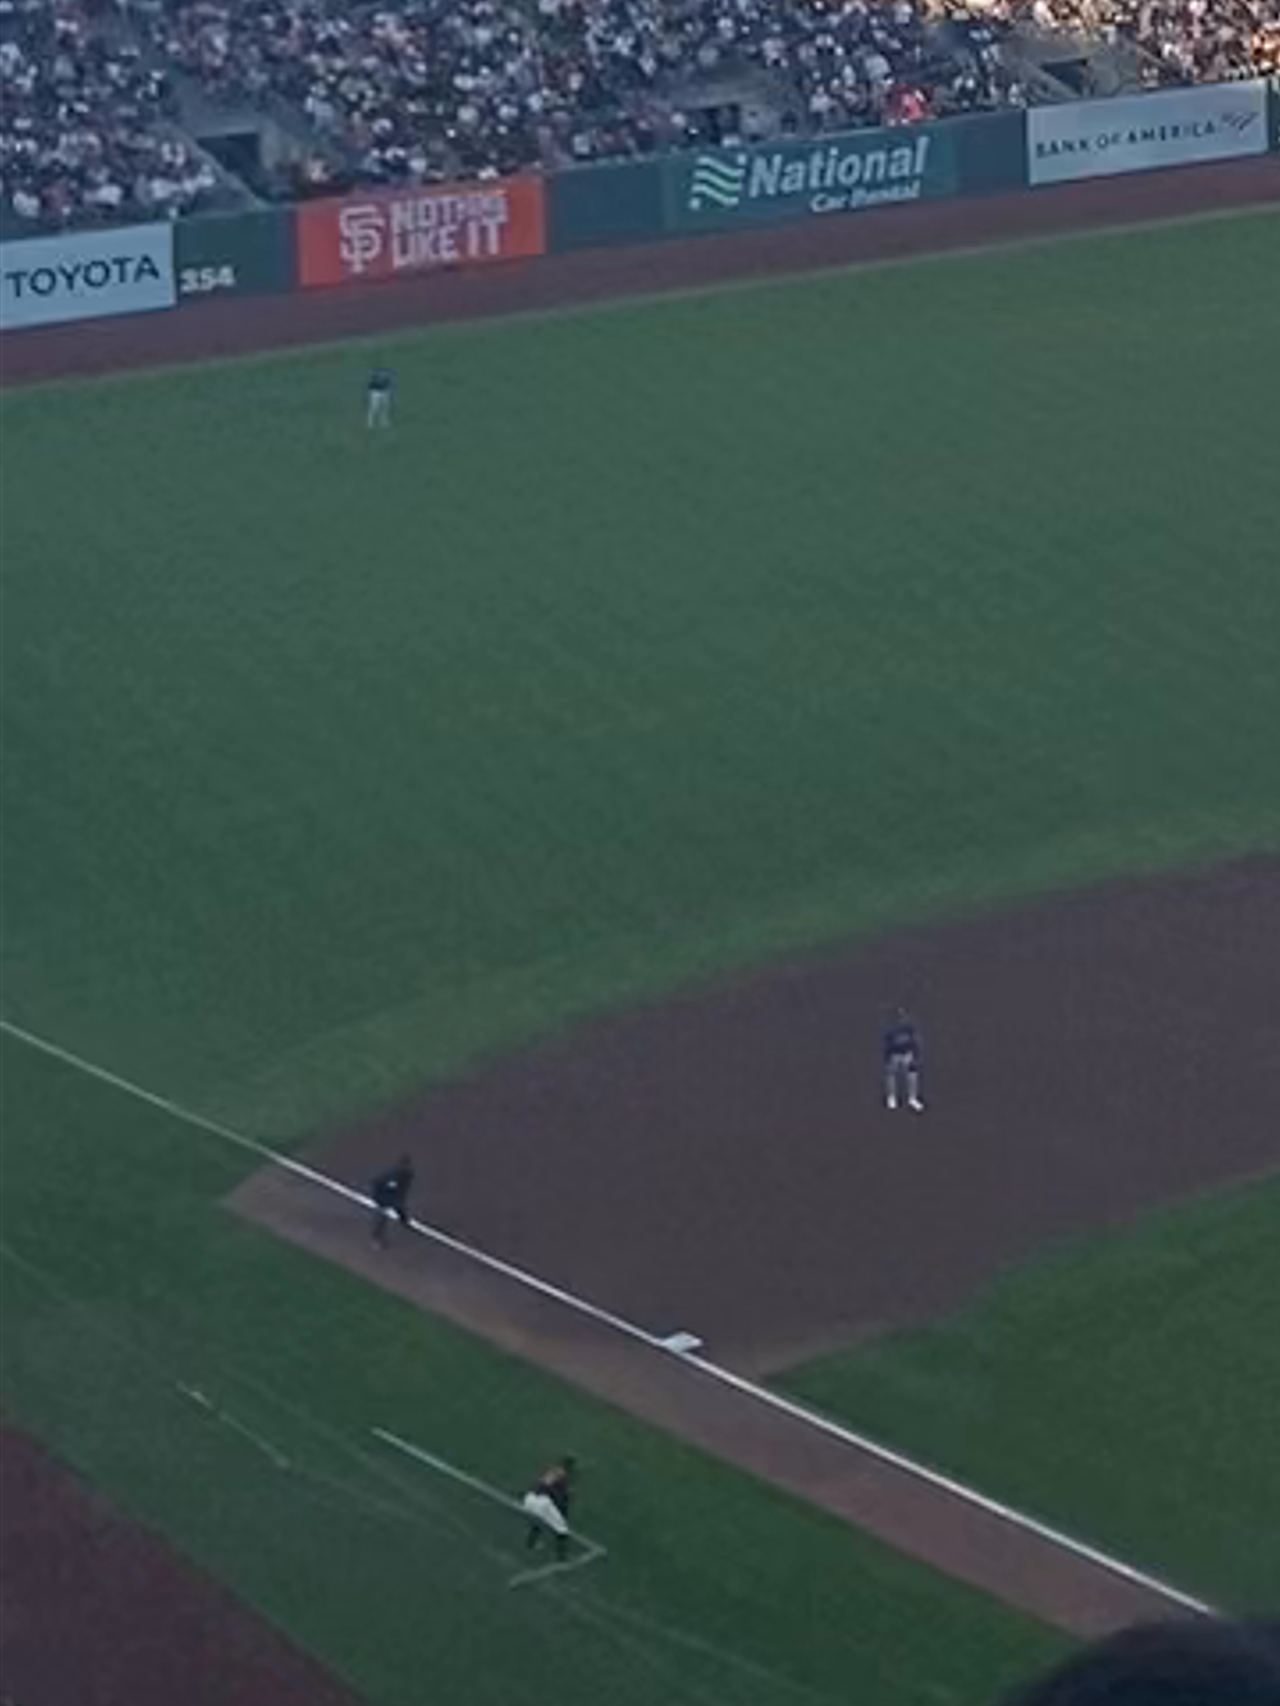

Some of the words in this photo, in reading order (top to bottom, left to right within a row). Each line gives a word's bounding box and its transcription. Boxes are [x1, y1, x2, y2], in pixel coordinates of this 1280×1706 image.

[1036, 137, 1091, 159] BANK
[1100, 130, 1121, 149] OF
[1128, 120, 1216, 144] AMERICA
[750, 136, 929, 198] National
[810, 193, 848, 213] Car
[392, 226, 458, 269] LIKE
[467, 219, 500, 257] IT
[4, 254, 161, 298] TOYOTA
